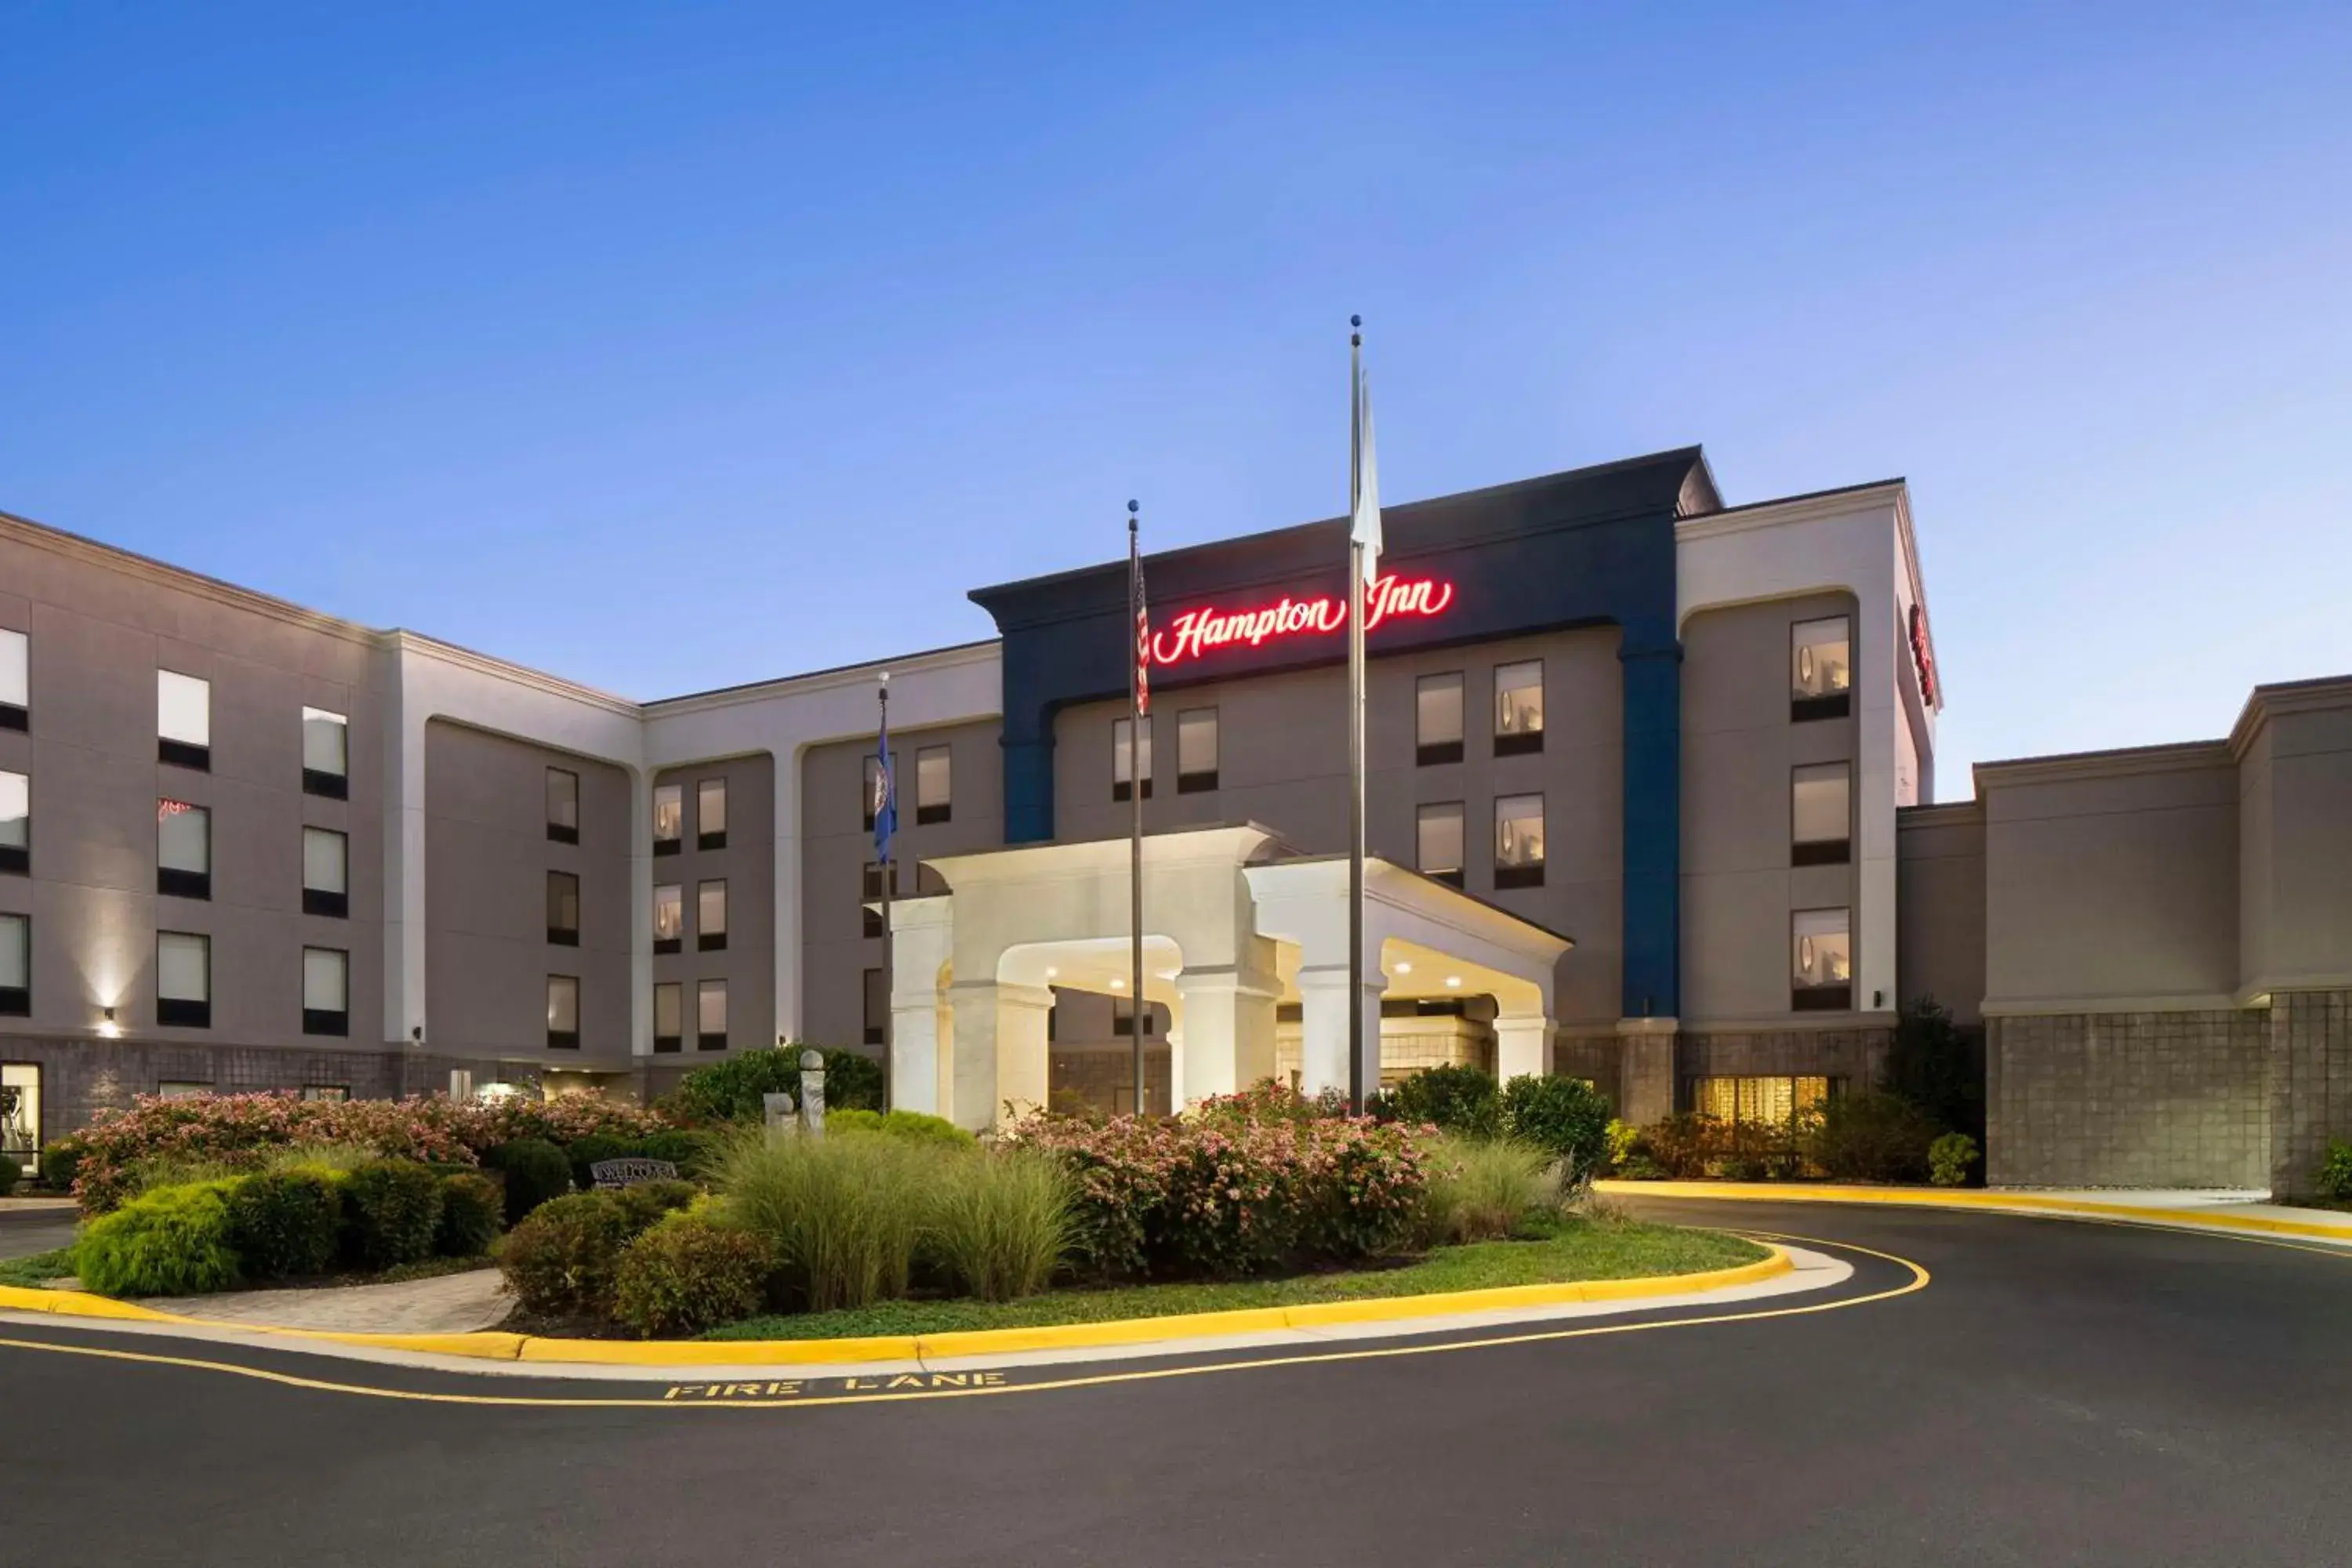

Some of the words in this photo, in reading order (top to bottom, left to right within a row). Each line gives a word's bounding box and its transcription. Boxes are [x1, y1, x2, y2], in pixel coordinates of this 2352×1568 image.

[1154, 598, 1346, 663] Hampton
[1363, 575, 1451, 630] Inn
[665, 1381, 803, 1399] FIRE
[846, 1373, 1007, 1389] LANE
